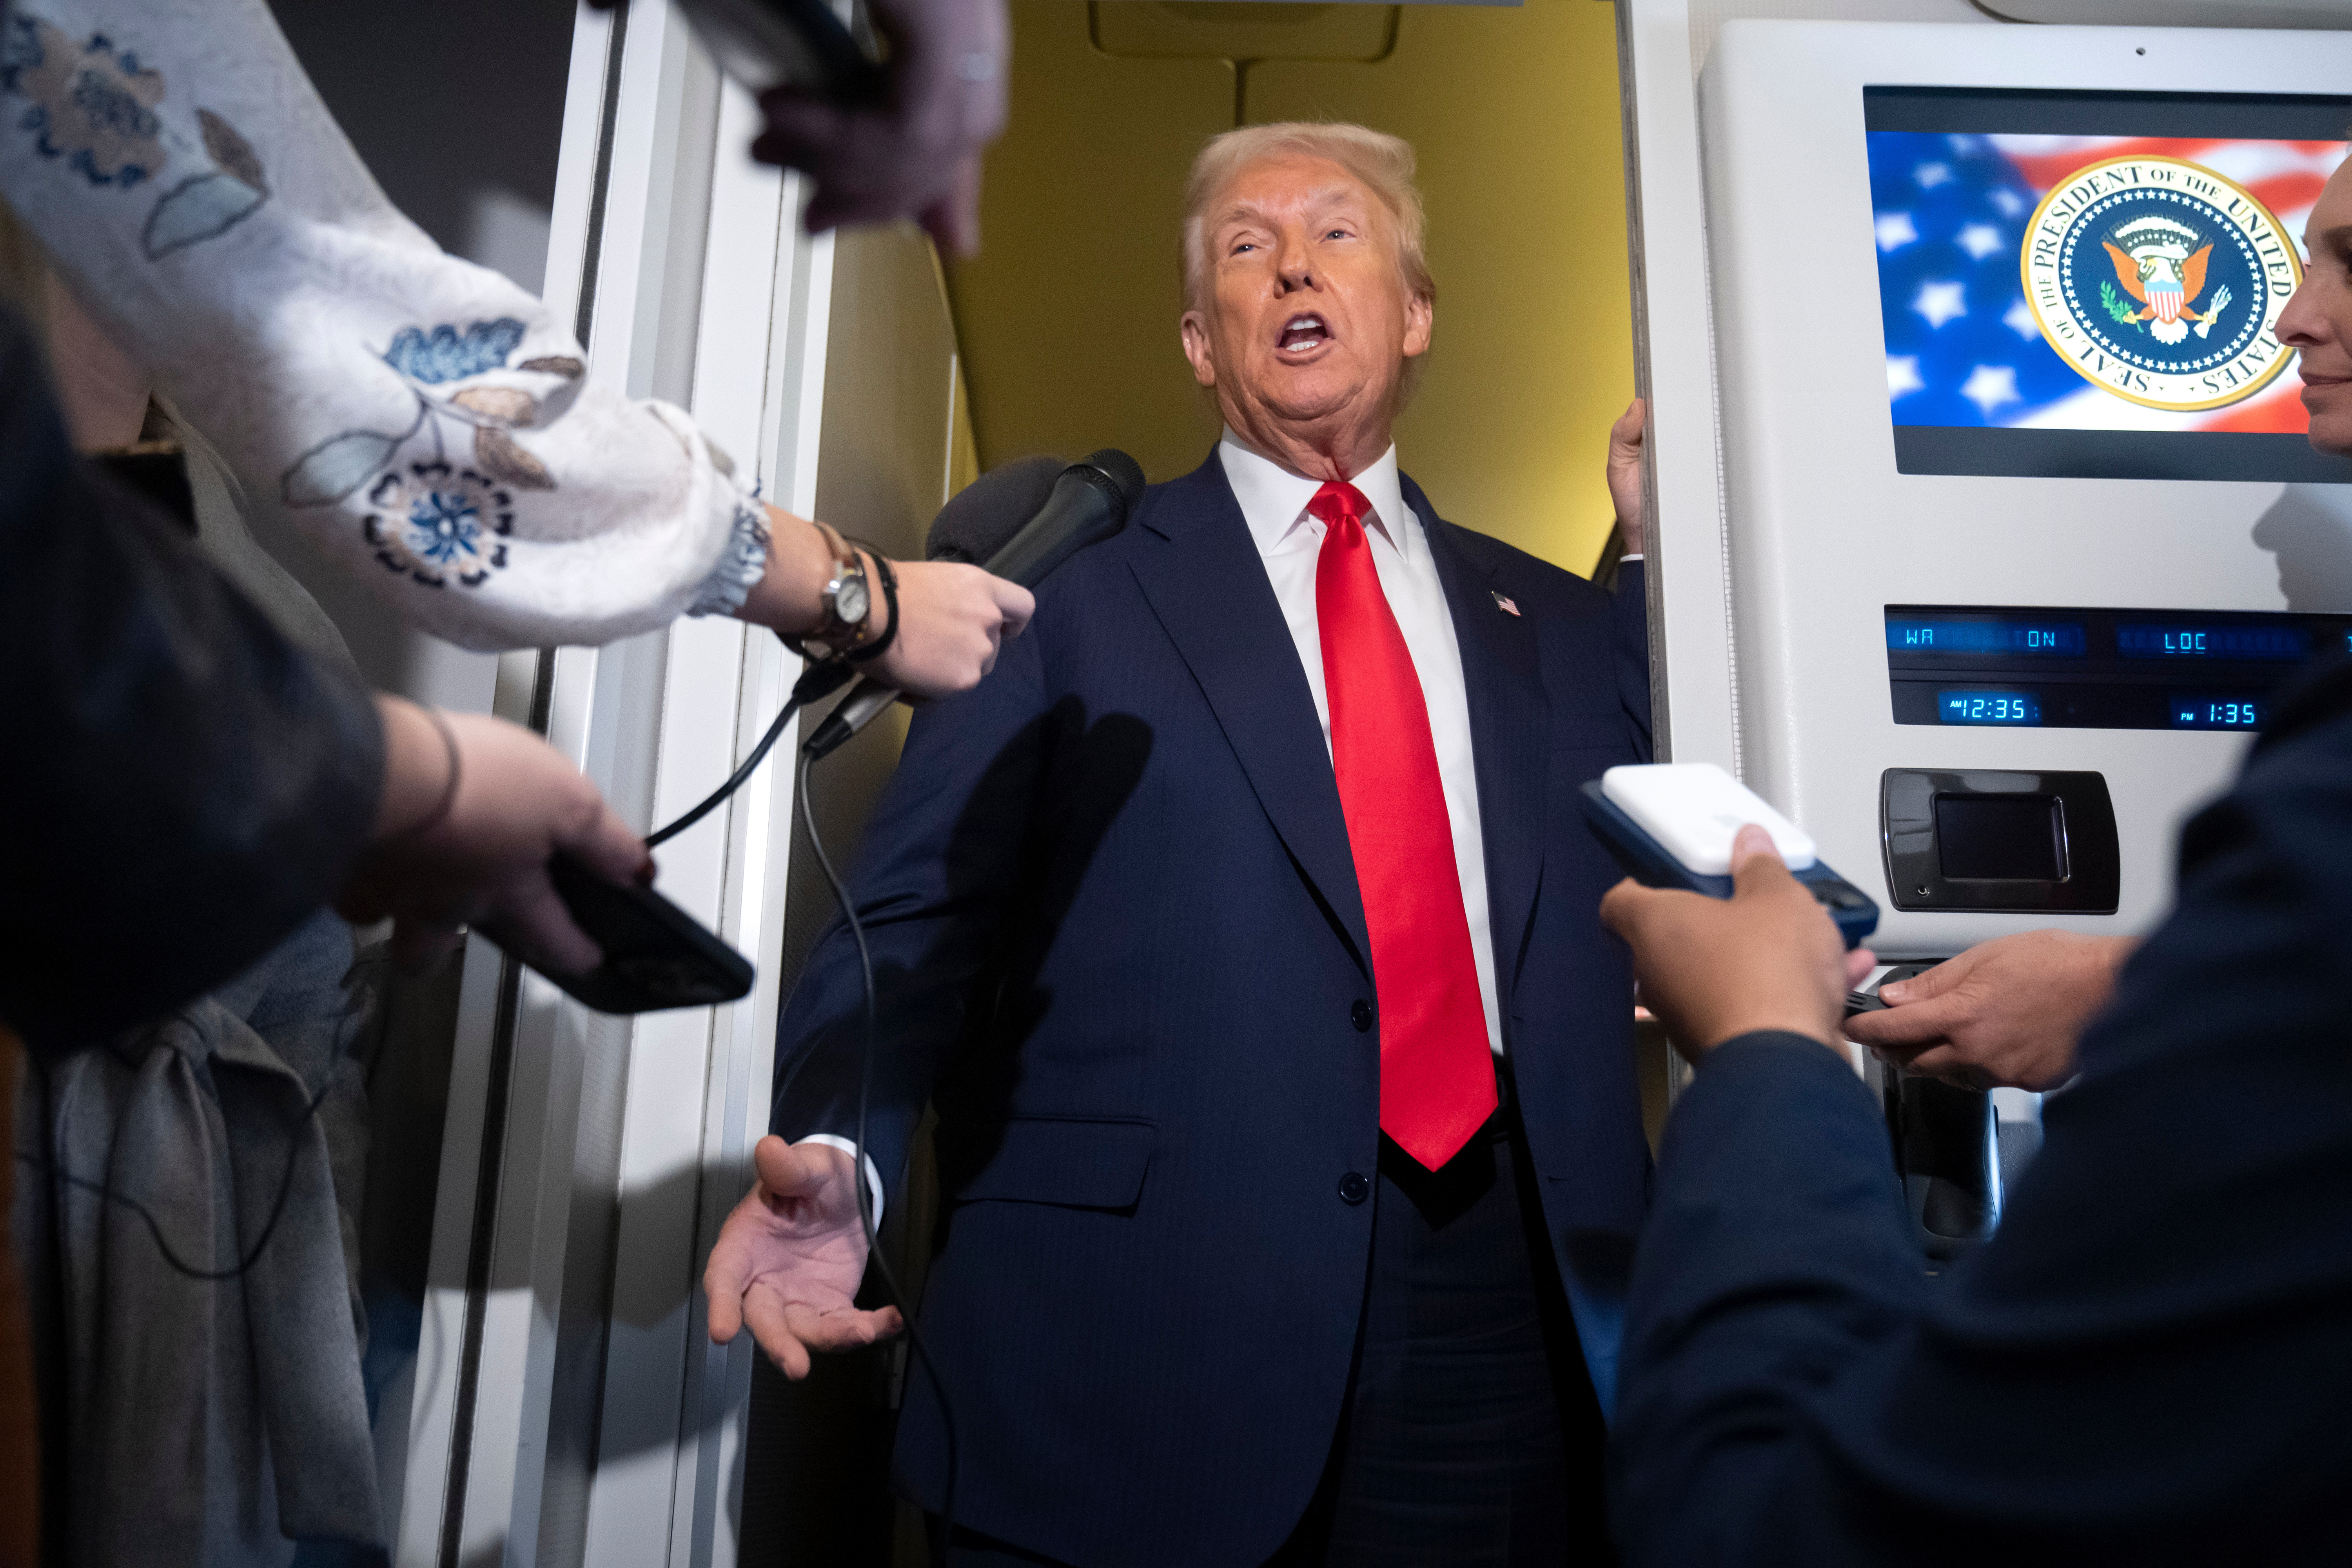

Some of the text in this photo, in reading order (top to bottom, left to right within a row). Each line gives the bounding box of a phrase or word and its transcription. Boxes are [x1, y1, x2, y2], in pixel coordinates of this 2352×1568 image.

[2151, 169, 2176, 182] OF
[2184, 174, 2221, 200] THE
[2034, 166, 2142, 269] PRESIDENT
[2228, 197, 2292, 297] UNITED
[2038, 276, 2058, 311] THE
[2053, 319, 2074, 339] OF
[2080, 340, 2150, 392] SEAL
[1906, 629, 1933, 644] WA
[2165, 633, 2205, 650] LOC
[1963, 700, 2024, 718] 12:35
[2210, 704, 2254, 723] 1:35
